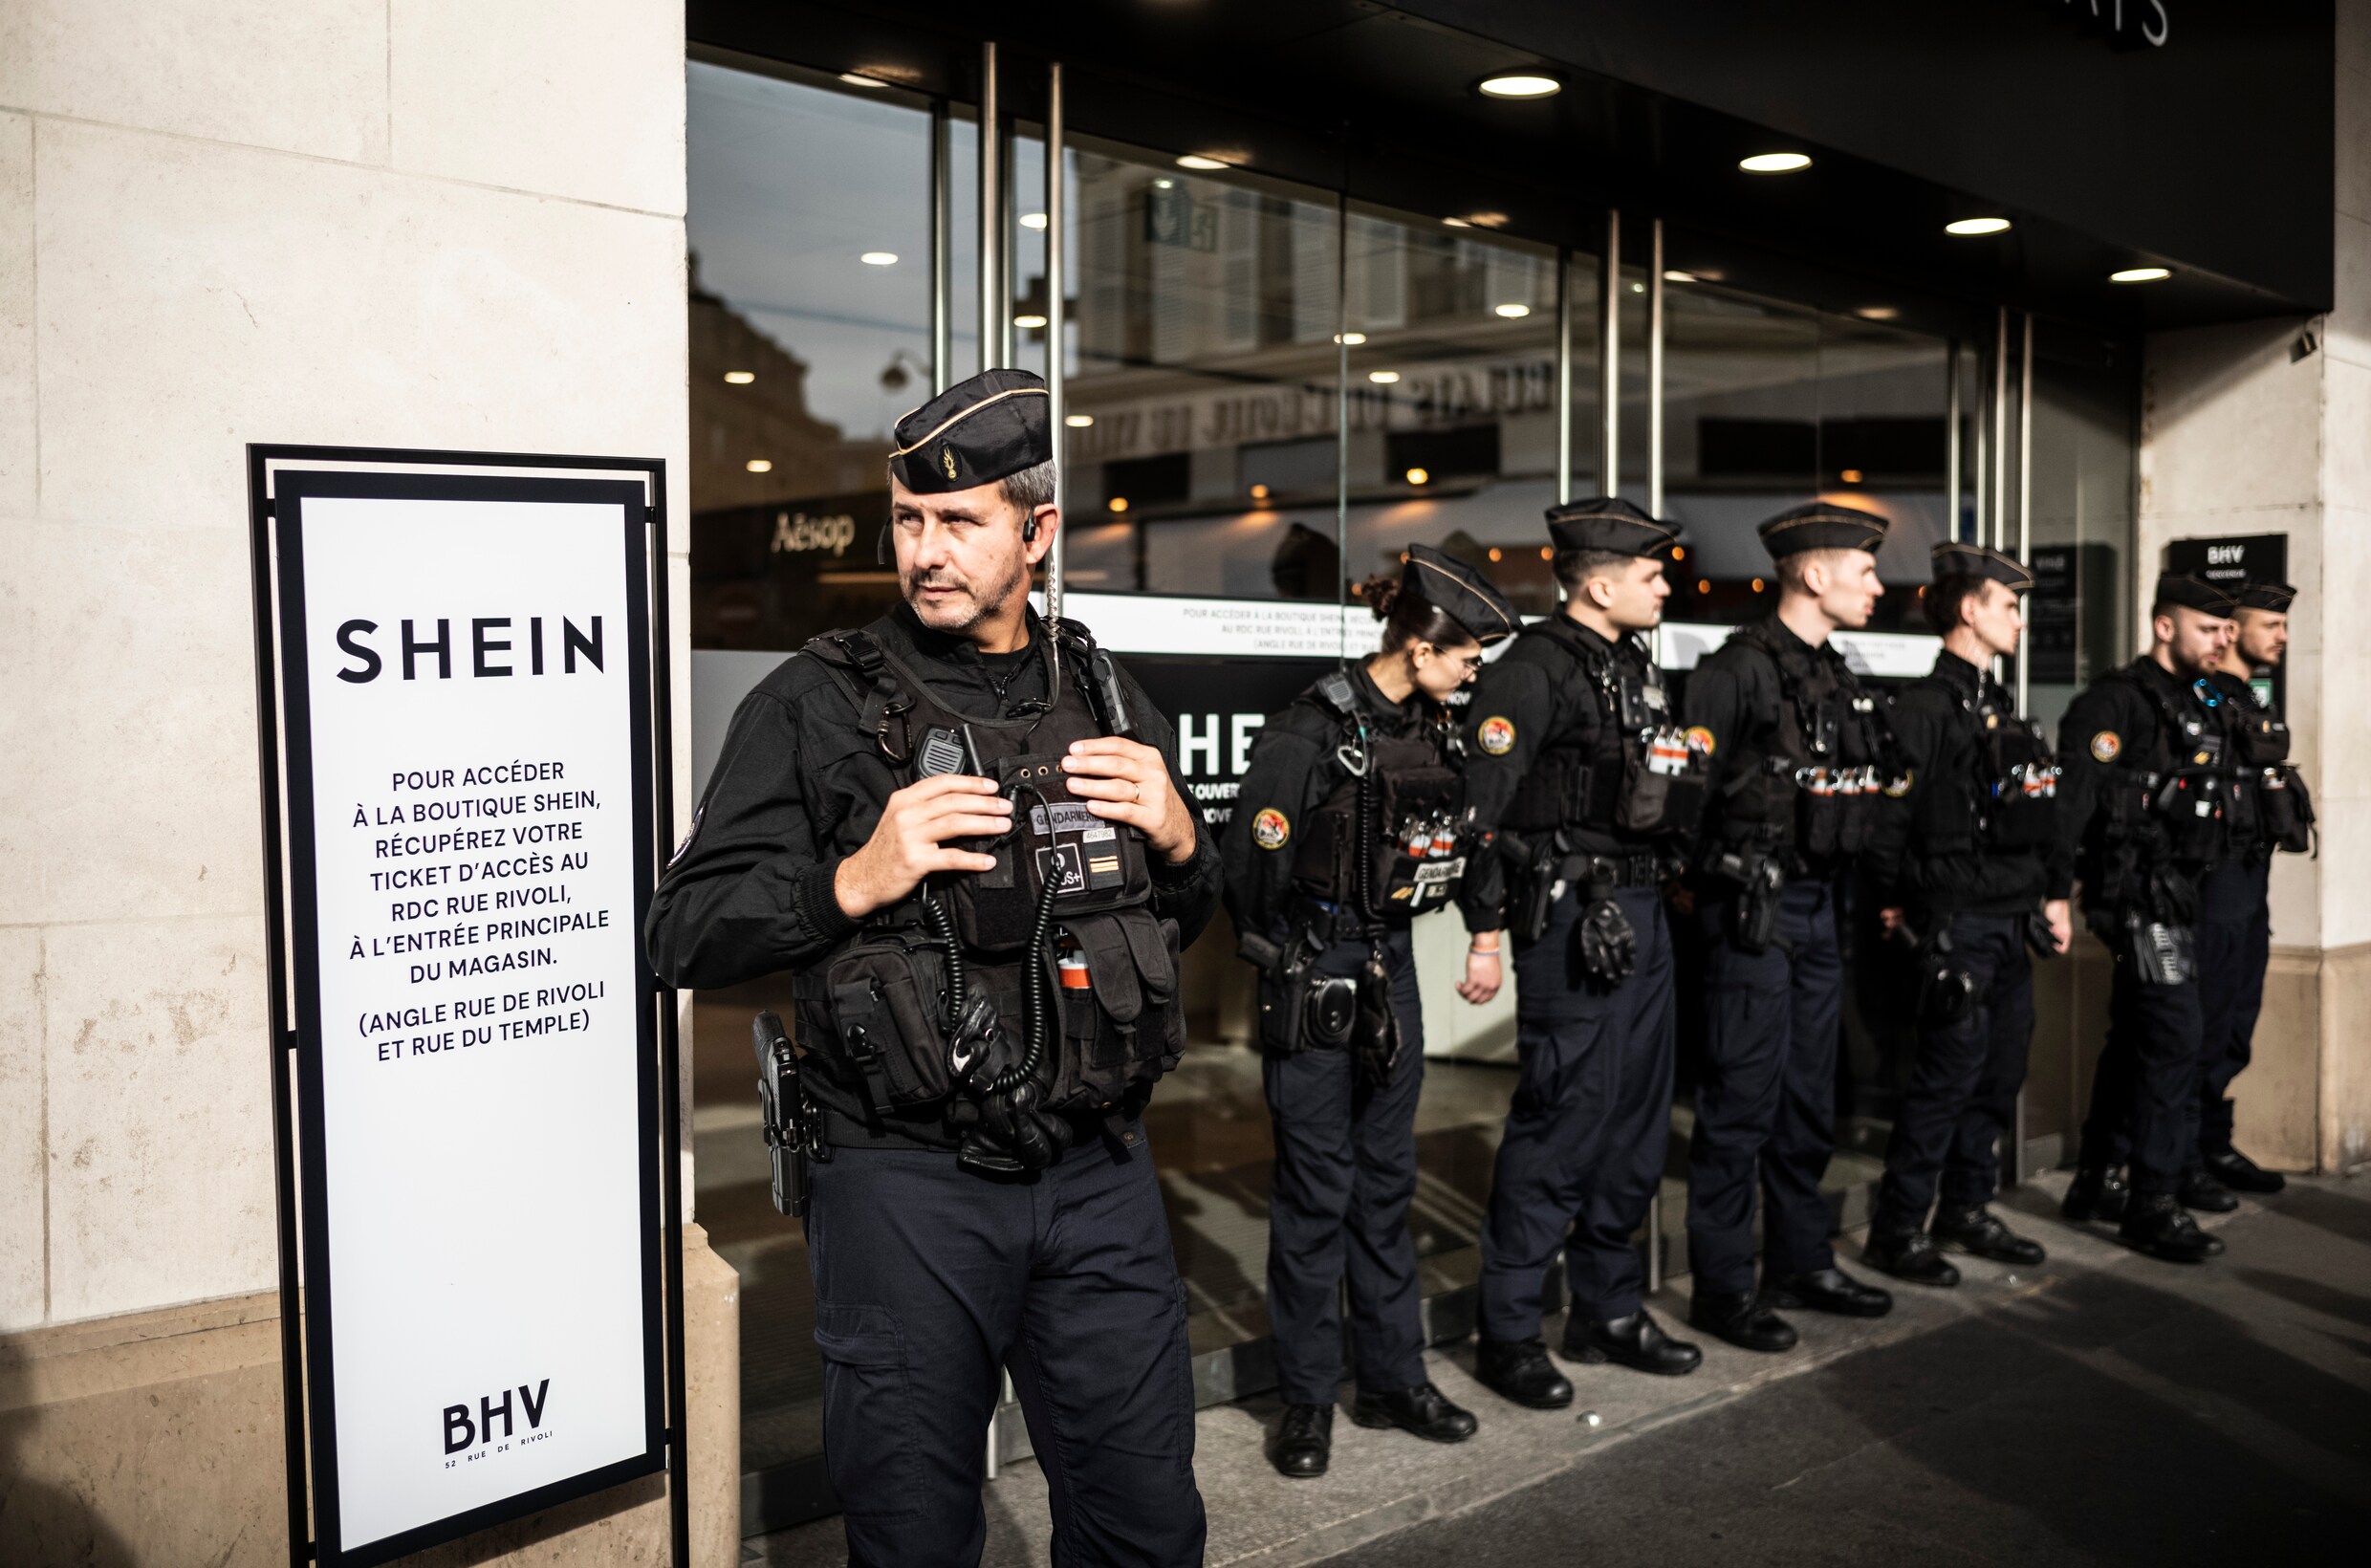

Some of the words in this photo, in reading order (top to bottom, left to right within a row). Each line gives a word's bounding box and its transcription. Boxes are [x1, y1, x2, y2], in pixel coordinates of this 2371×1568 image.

[2208, 544, 2246, 565] BHV
[1184, 608, 1207, 619] POUR
[1275, 612, 1316, 622] BOUTIQUE
[1319, 613, 1343, 623] SHEIN
[1236, 624, 1253, 634] RDC
[1256, 625, 1272, 634] RUE
[336, 615, 604, 684] SHEIN
[1289, 640, 1303, 649] RUE
[1306, 641, 1316, 649] DE
[1447, 691, 1471, 706] NOV
[1179, 713, 1265, 775] HE
[393, 770, 455, 792] POUR
[463, 759, 564, 786] ACCÉDER
[353, 803, 369, 828] À
[377, 806, 405, 826] LA
[413, 795, 527, 822] BOUTIQUE
[533, 790, 600, 812] SHEIN,
[1036, 810, 1101, 825] GENDARMERI
[376, 827, 506, 859] RÉCUPÉREZ
[512, 822, 582, 845] VOTRE
[370, 866, 451, 891] TICKET
[459, 852, 554, 882] D'ACCÈS
[560, 852, 588, 872] AU
[392, 900, 439, 922] RDC
[446, 893, 489, 915] RUE
[496, 884, 572, 909] RIVOLI,
[350, 935, 365, 960] À
[373, 923, 479, 957] L'ENTRÉE
[487, 909, 609, 942] PRINCIPALE
[410, 962, 441, 984] DU
[448, 947, 557, 978] MAGASIN.
[359, 1004, 446, 1037] (ANGLE
[454, 997, 495, 1020] RUE
[503, 991, 530, 1013] DE
[536, 980, 604, 1008] RIVOLI
[378, 1040, 404, 1061] ET
[412, 1032, 454, 1056] RUE
[462, 1026, 491, 1048] DU
[499, 1009, 589, 1041] TEMPLE)
[444, 1379, 550, 1455] BHV
[445, 1460, 456, 1470] 52
[468, 1450, 487, 1462] RUE
[497, 1444, 510, 1453] DE
[521, 1430, 553, 1446] RIVOLI
